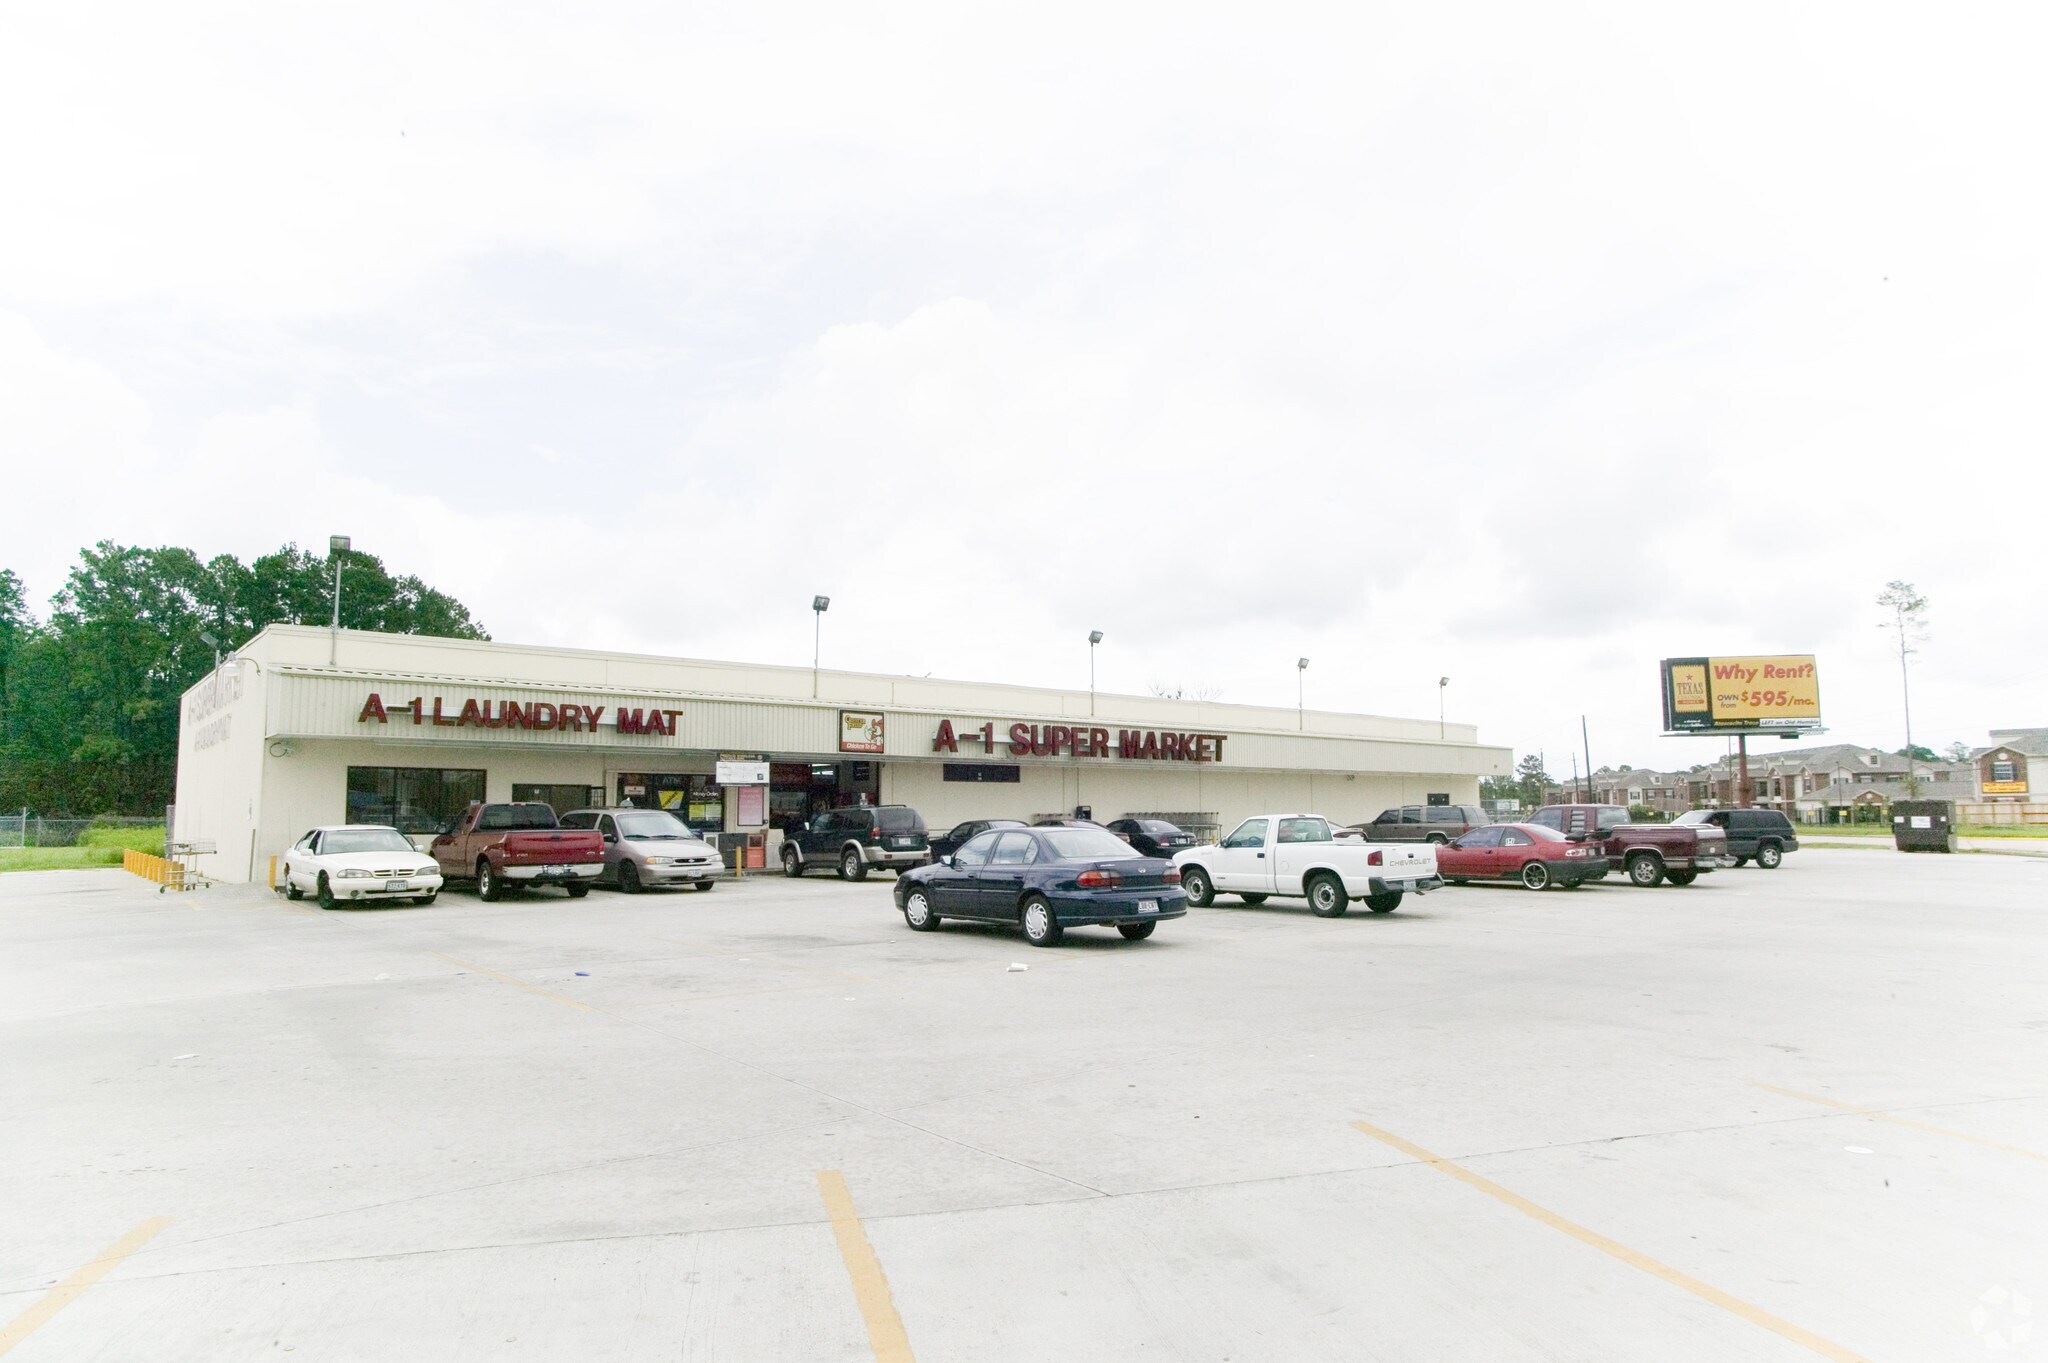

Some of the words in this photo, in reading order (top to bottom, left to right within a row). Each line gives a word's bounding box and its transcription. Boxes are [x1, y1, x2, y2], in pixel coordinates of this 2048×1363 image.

[1714, 663, 1759, 684] Why
[1763, 663, 1814, 679] Rent?
[1677, 682, 1703, 694] TEXAS
[1717, 694, 1740, 702] OWN
[358, 693, 422, 725] A-1
[433, 697, 606, 733] LAUNDRY
[617, 706, 683, 736] MAT
[933, 719, 994, 754] A-1
[1009, 723, 1109, 759] SUPER
[1119, 729, 1227, 763] MARKET
[1389, 858, 1431, 867] CHEVROLET
